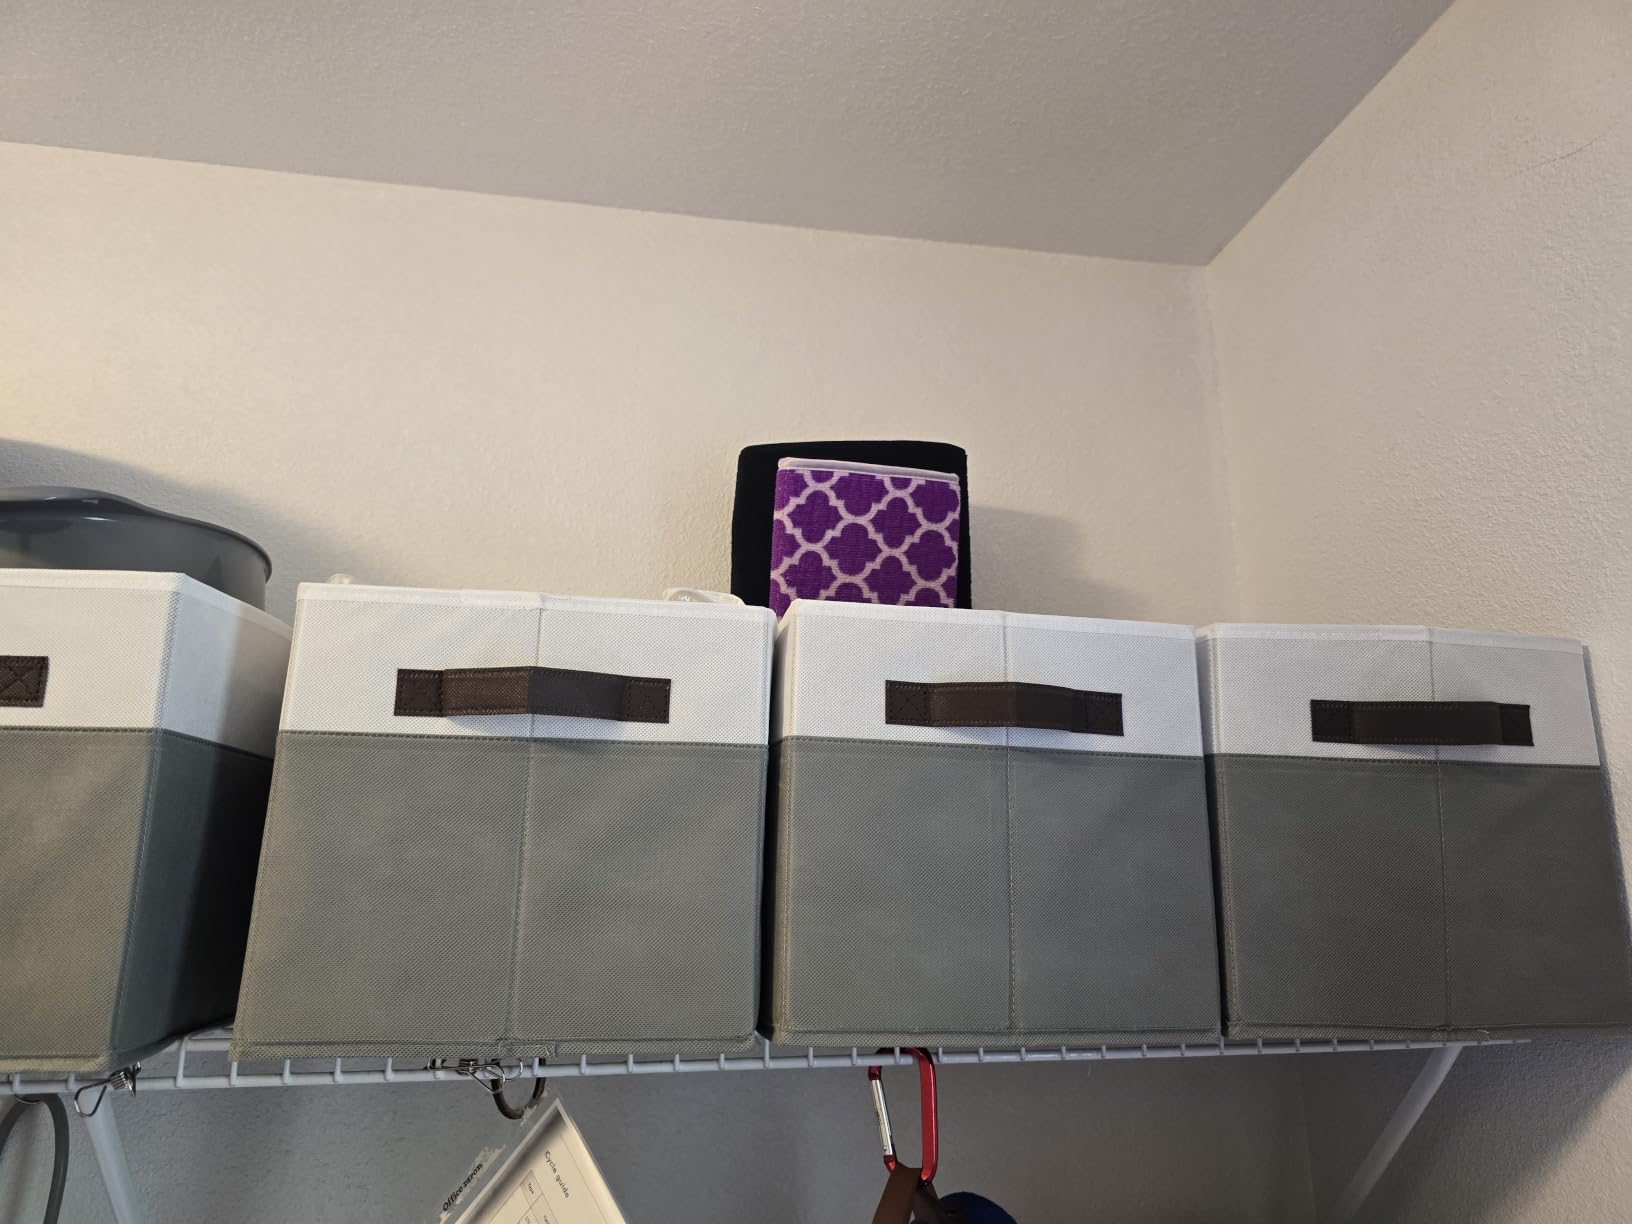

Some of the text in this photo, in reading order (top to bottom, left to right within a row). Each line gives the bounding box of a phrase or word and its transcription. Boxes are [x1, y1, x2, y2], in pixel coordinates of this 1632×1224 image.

[544, 1150, 569, 1198] Cycle guide
[442, 1186, 463, 1211] Office
